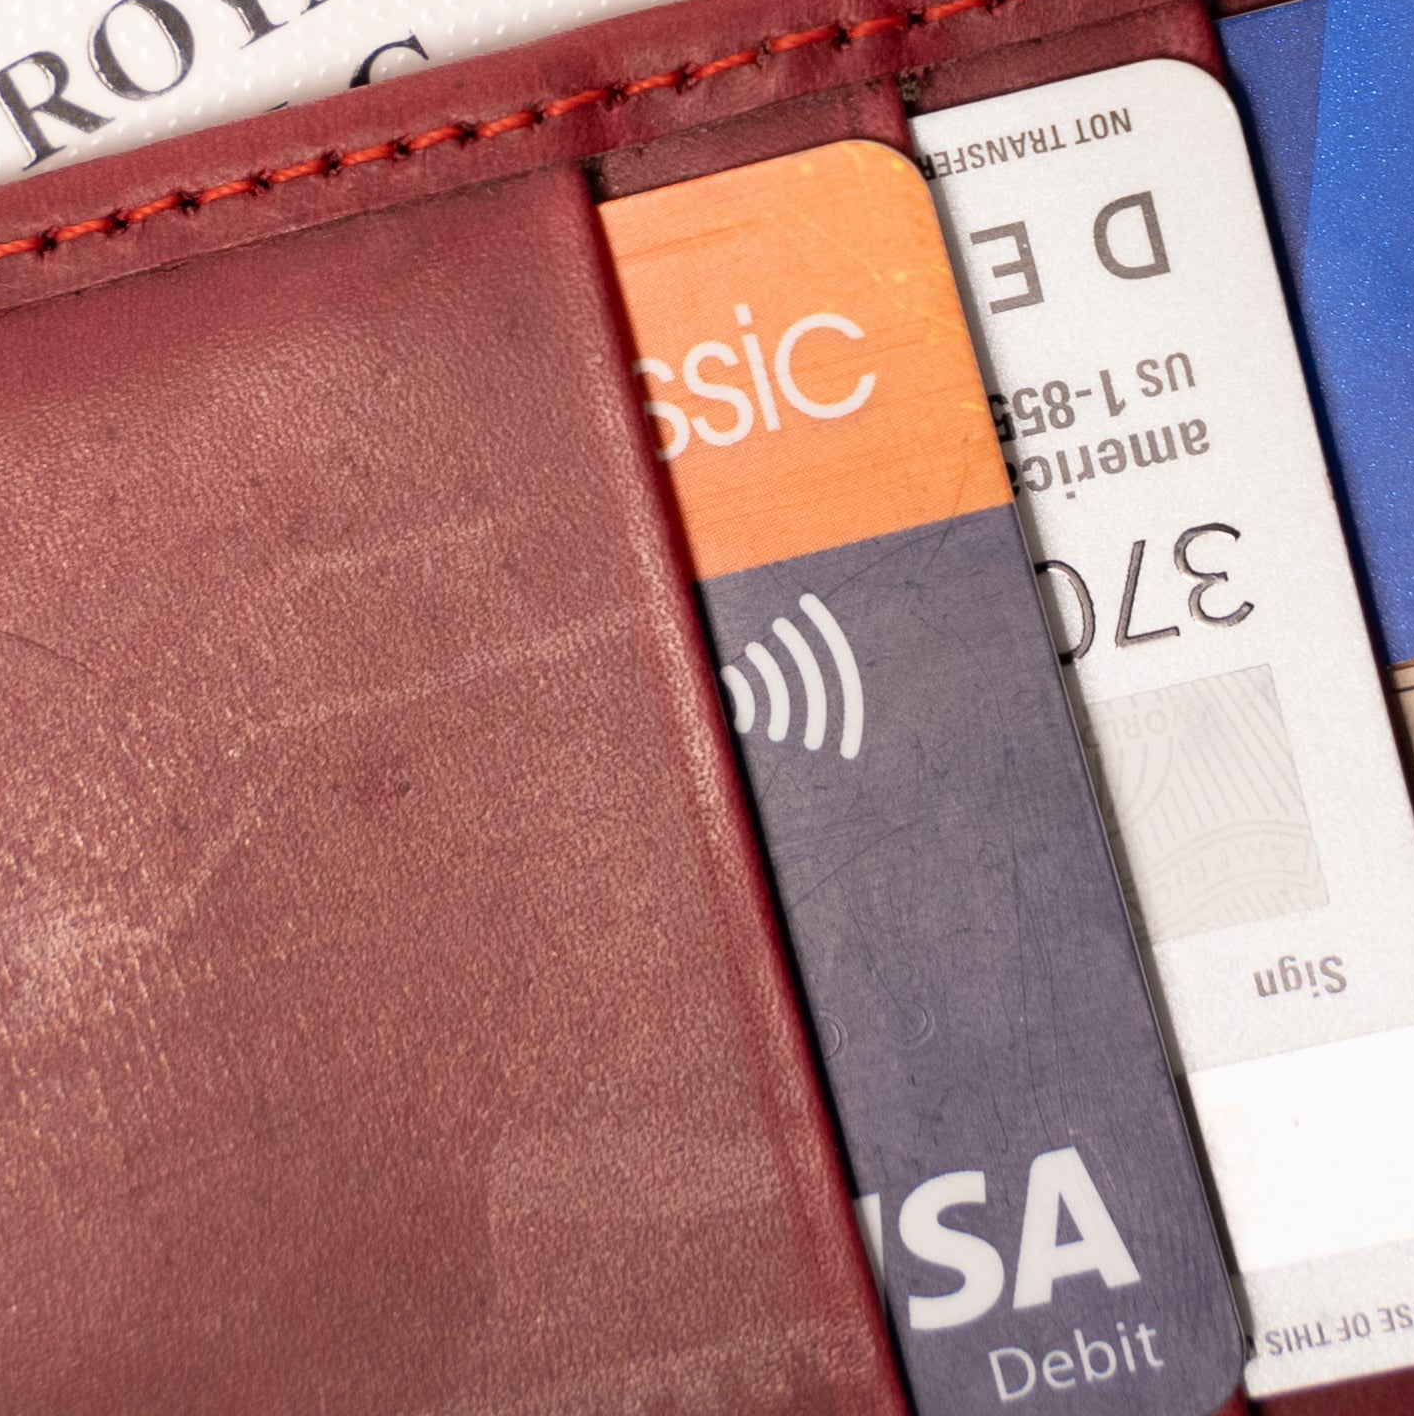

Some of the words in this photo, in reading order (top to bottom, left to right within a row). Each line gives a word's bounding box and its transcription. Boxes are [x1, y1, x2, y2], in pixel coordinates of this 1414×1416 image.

[1074, 107, 1133, 146] NOT
[1142, 351, 1196, 398] US
[1253, 955, 1347, 998] Sign
[1264, 1320, 1331, 1356] THIS
[1337, 1311, 1372, 1342] OF
[989, 1321, 1164, 1403] Debit
